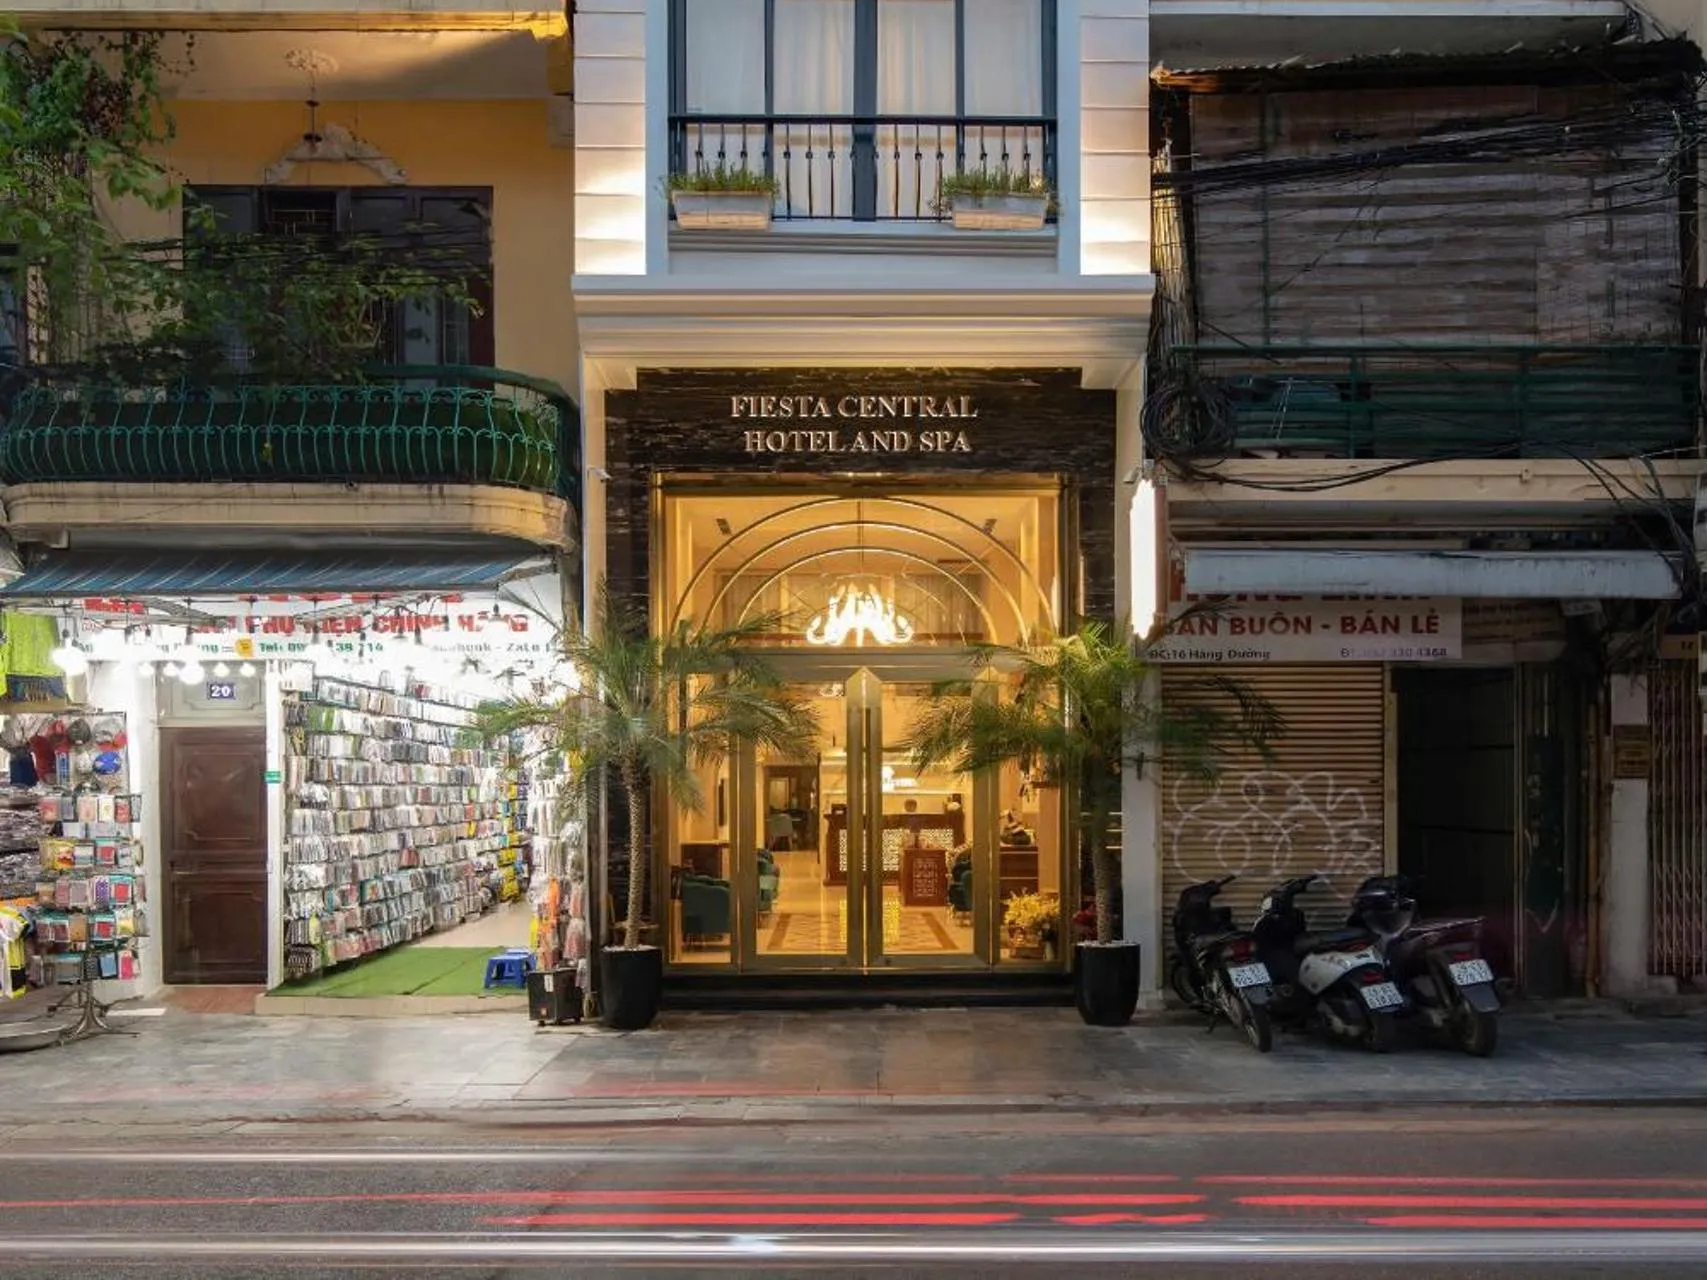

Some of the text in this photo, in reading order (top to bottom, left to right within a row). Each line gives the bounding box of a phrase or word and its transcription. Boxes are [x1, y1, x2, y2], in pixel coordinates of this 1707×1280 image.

[730, 396, 979, 418] FIESTA CENTRAL
[743, 430, 972, 453] HOTEL AND SPA
[1229, 610, 1312, 636] BUÔN
[1340, 608, 1401, 635] BÁN
[1411, 606, 1440, 634] LẺ
[210, 684, 232, 697] 20
